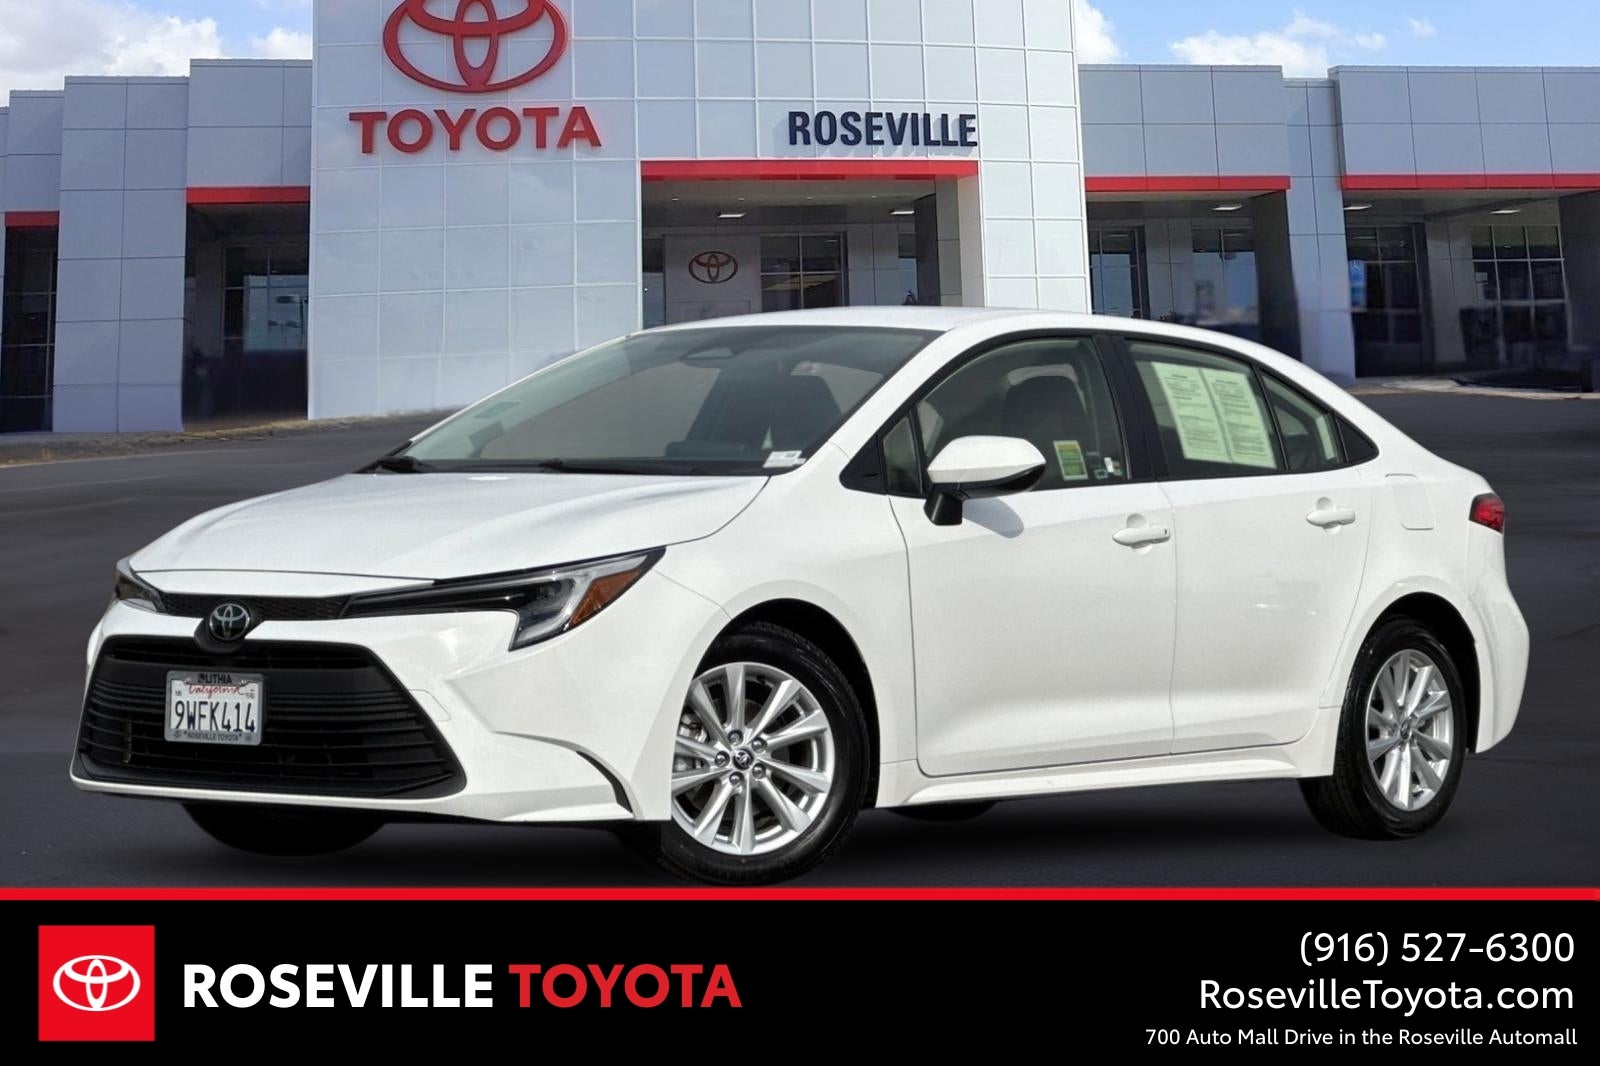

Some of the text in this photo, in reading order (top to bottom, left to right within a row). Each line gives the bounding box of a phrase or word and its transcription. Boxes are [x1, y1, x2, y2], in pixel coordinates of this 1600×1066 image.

[349, 106, 602, 154] TOYOTA
[788, 110, 979, 148] ROSEVILLE
[189, 684, 241, 698] California
[206, 673, 233, 684] LITHIA
[174, 700, 256, 732] 9WFK414
